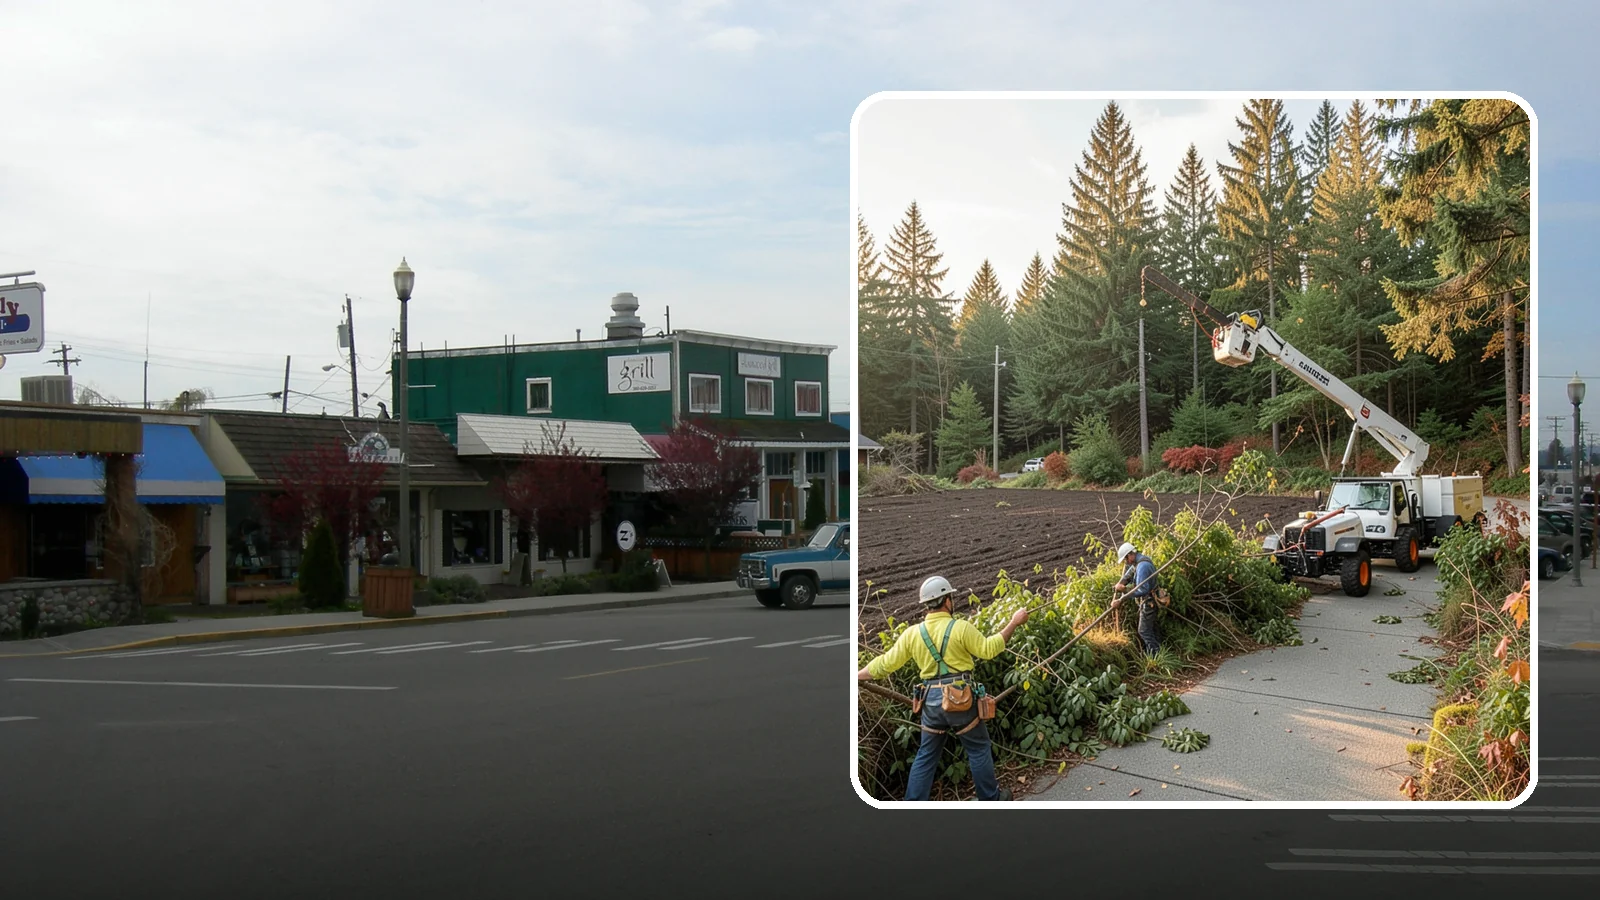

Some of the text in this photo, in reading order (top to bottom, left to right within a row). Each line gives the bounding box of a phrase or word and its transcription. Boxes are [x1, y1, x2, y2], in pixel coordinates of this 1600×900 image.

[3, 337, 37, 346] Fries Salads
[618, 356, 655, 391] grill
